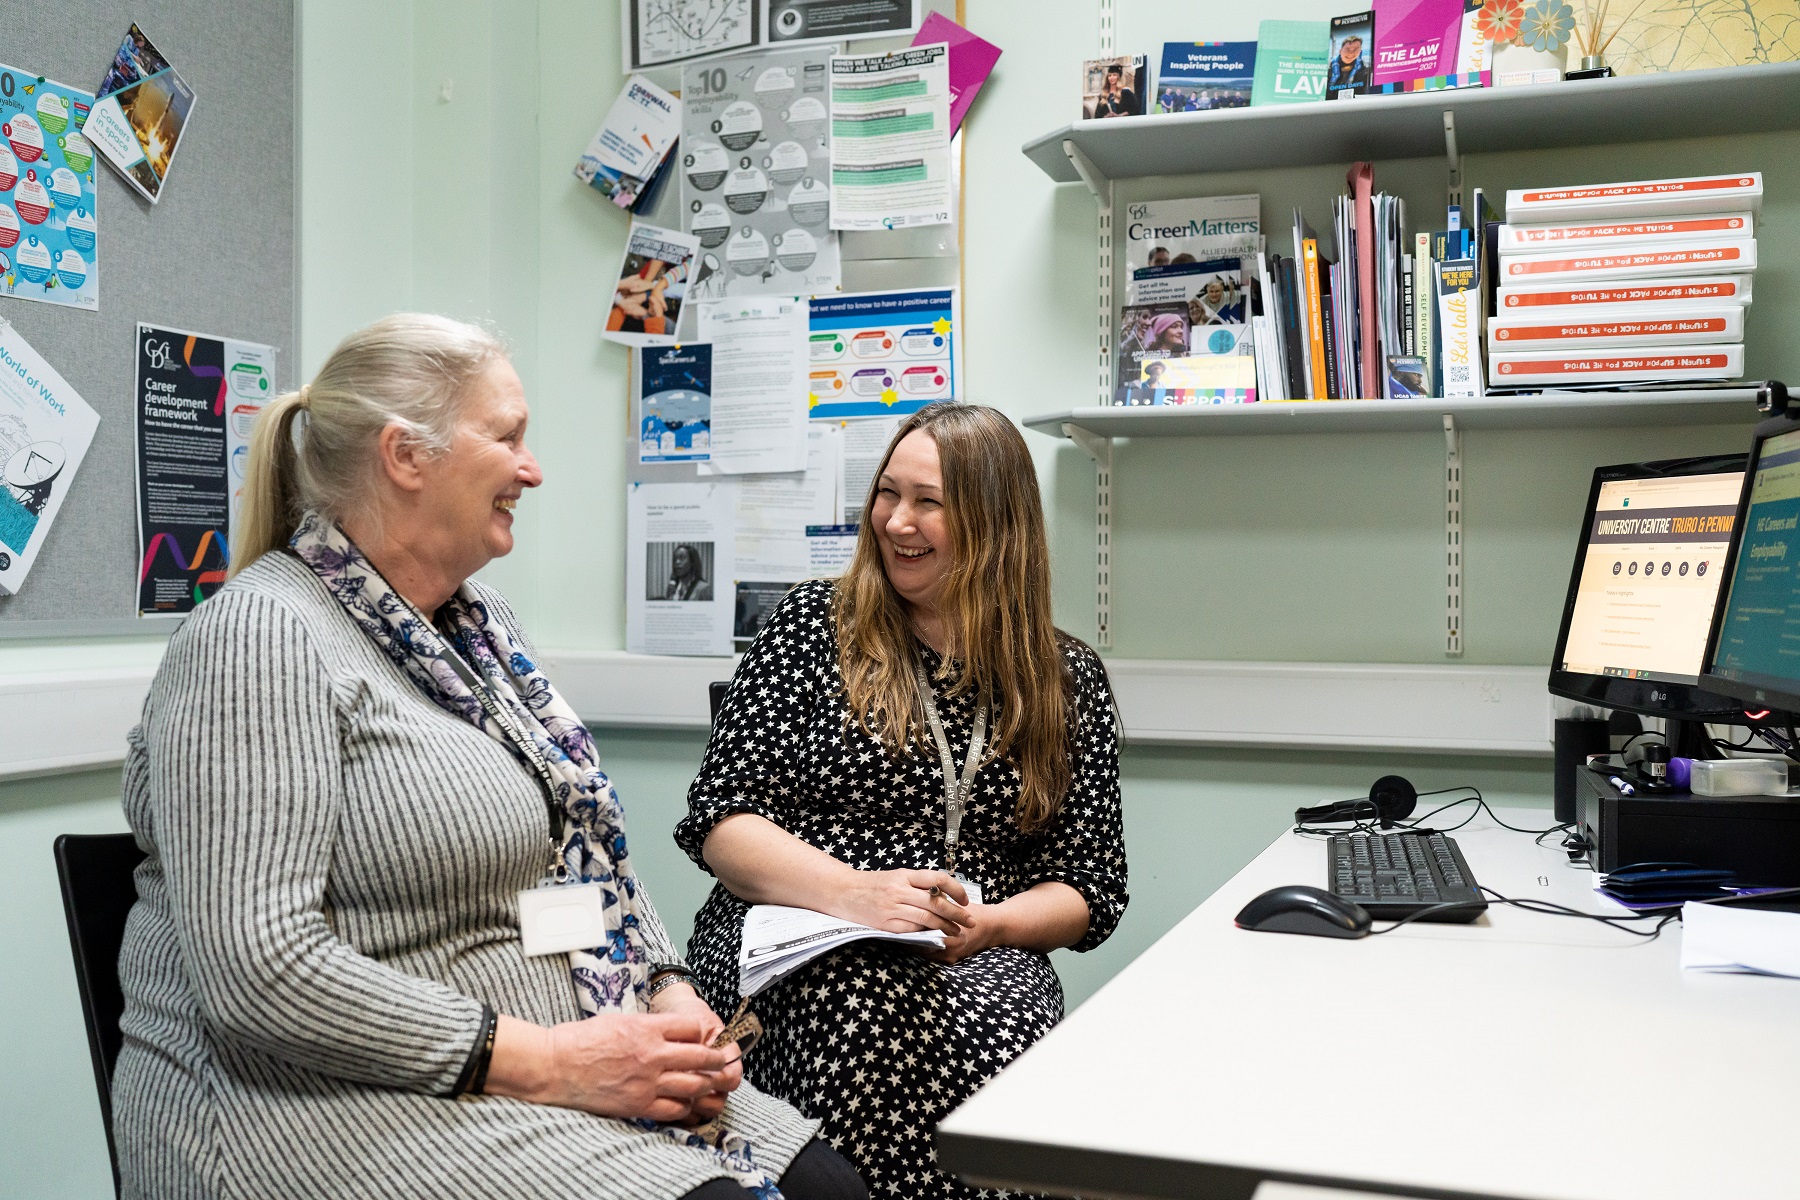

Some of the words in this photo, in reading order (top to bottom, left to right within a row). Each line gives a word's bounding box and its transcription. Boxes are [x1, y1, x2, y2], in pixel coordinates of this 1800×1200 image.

[883, 54, 904, 64] ABOUT
[905, 50, 926, 58] GREEN
[1380, 50, 1407, 62] THE
[1410, 43, 1440, 59] LAW
[880, 60, 906, 70] TALKING
[1170, 62, 1210, 71] Inspiring
[1212, 62, 1244, 71] People
[1376, 59, 1421, 69] APPRENTICESHIPS
[1419, 62, 1438, 71] 2021
[688, 86, 702, 95] Top
[698, 68, 726, 94] 10
[1274, 74, 1328, 94] LAW
[61, 97, 69, 107] 10
[632, 83, 671, 113] CORNWALL
[691, 106, 712, 114] skills
[4, 125, 9, 135] 1
[100, 108, 130, 142] Careers
[95, 116, 104, 127] in
[105, 126, 128, 152] space
[59, 139, 64, 148] 9
[28, 171, 34, 180] 3
[46, 178, 51, 186] 8
[79, 208, 84, 216] 7
[693, 201, 700, 212] 4
[936, 212, 948, 221] 1/2
[743, 227, 750, 236] 5
[1128, 220, 1258, 241] CareerMatters
[30, 236, 36, 246] 5
[55, 252, 60, 261] 6
[1228, 246, 1257, 254] HEALTH
[1442, 272, 1459, 280] WE'RE
[1460, 270, 1474, 278] HERE
[1138, 288, 1172, 296] information
[1629, 290, 1650, 298] PACK
[830, 303, 846, 312] need
[855, 302, 872, 310] know
[882, 300, 896, 308] have
[903, 297, 928, 308] positive
[930, 296, 950, 304] career
[1448, 286, 1468, 328] talk
[1450, 332, 1468, 364] Let's
[145, 378, 177, 393] Career
[27, 375, 39, 388] of
[40, 384, 66, 416] Work
[144, 391, 208, 410] development
[144, 404, 198, 421] framework
[1598, 519, 1641, 536] UNIVERSITY
[1640, 518, 1672, 534] CENTRE
[1672, 516, 1698, 533] TRURO
[1698, 516, 1705, 532] &
[1756, 518, 1764, 532] HE
[1764, 517, 1785, 532] Careers
[1785, 512, 1799, 530] and
[1750, 541, 1788, 562] Employability
[471, 684, 498, 716] STUDENT
[925, 702, 938, 726] STAFF
[977, 706, 986, 726] STAFF
[493, 712, 522, 742] COLLEGE
[517, 740, 546, 772] PENWITH
[939, 740, 950, 765] STAFF
[970, 736, 982, 762] STAFF
[947, 782, 956, 811] STAFF
[958, 778, 970, 806] STAFF
